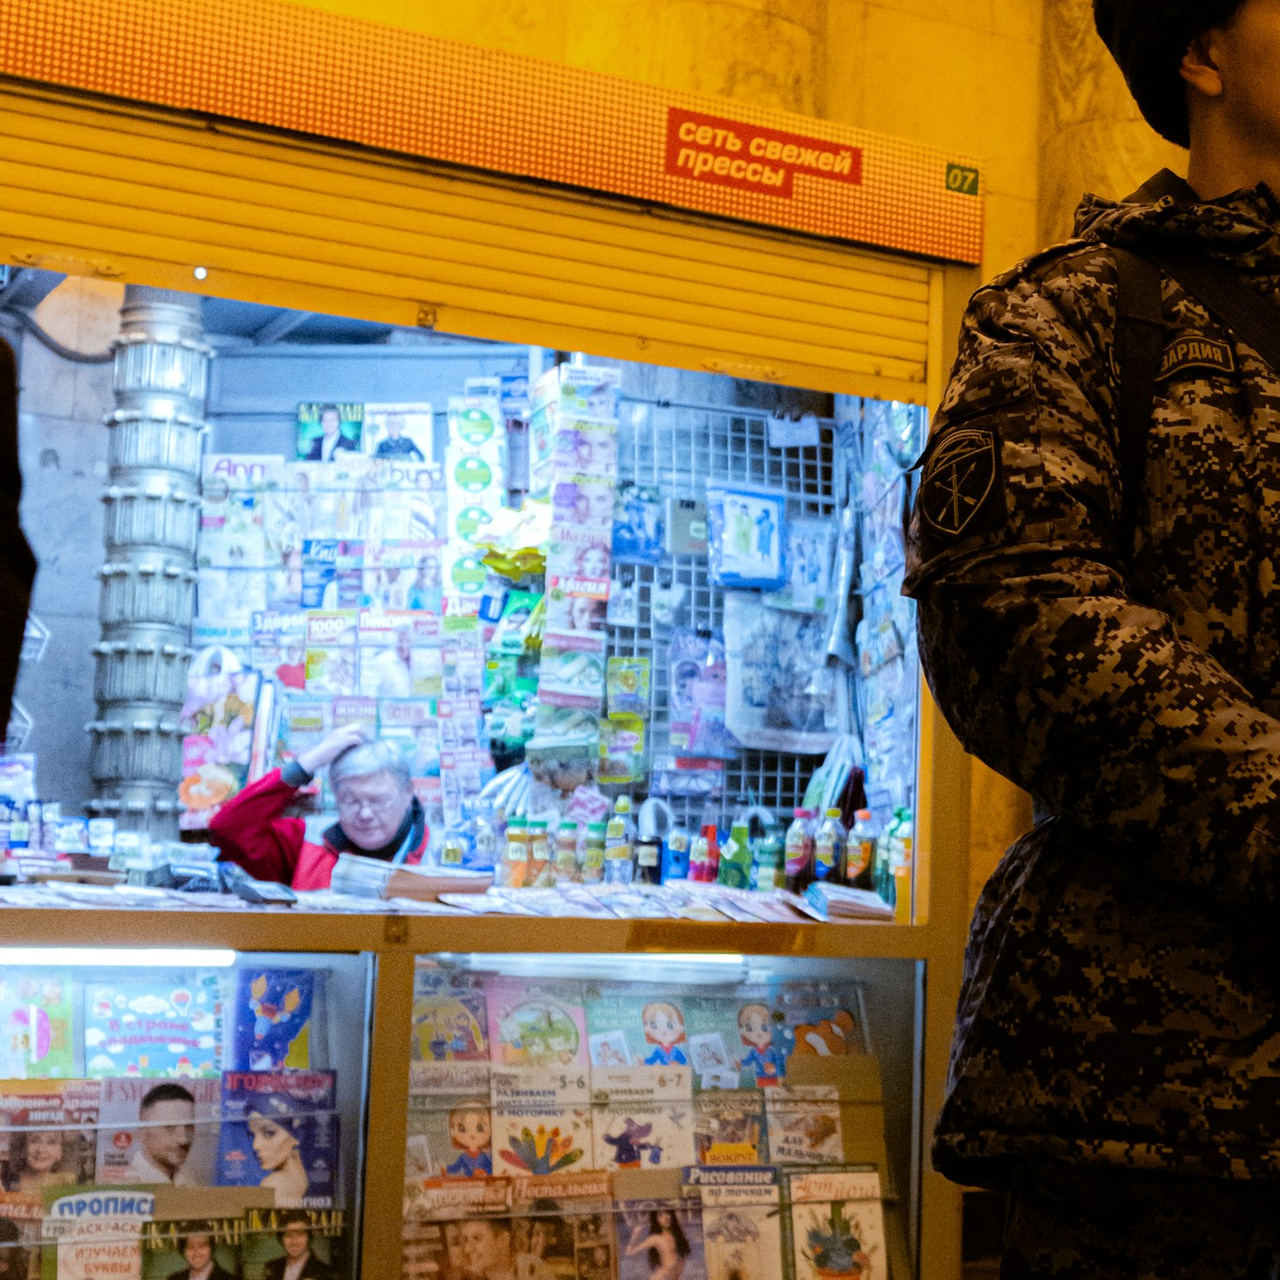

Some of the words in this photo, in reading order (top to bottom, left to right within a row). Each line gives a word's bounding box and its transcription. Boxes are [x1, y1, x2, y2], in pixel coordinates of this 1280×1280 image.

[678, 122, 742, 152] сеть
[749, 137, 852, 175] свежей
[677, 148, 785, 187] прессы
[948, 168, 976, 191] 07
[557, 576, 609, 595] Магия
[308, 617, 344, 635] 1000
[559, 1074, 585, 1089] 5-6
[658, 1074, 682, 1088] 6-7
[497, 1090, 556, 1098] РАЗВИВАЕМ
[507, 1109, 565, 1117] МОТОРИКУ
[689, 1170, 773, 1184] Рисование
[725, 1188, 772, 1197] точкам
[83, 1262, 131, 1275] БУКВЫ
